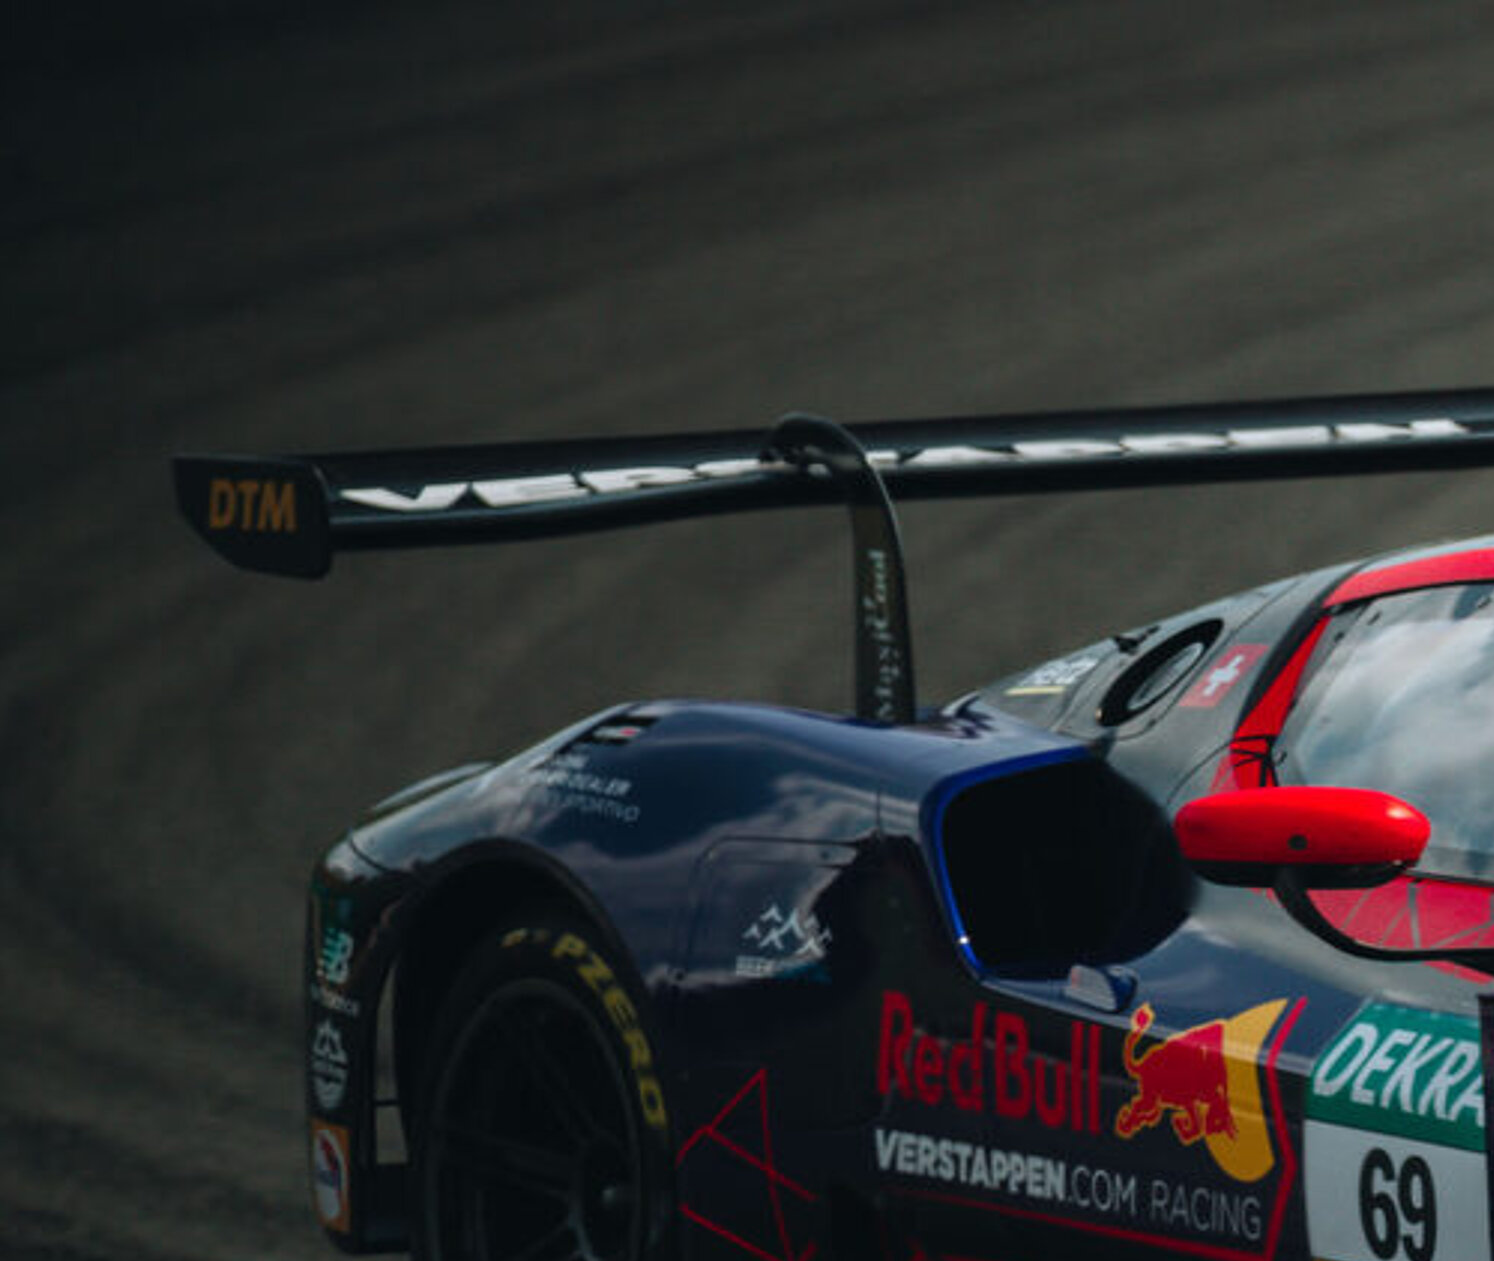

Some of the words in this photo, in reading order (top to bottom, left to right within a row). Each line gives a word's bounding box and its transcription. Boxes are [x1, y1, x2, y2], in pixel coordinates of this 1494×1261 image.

[208, 478, 297, 533] DTM
[877, 989, 986, 1117] Red
[994, 1010, 1102, 1137] Bull
[874, 1127, 1138, 1214] VERSTAPPEN.COM
[1150, 1179, 1263, 1241] RACING
